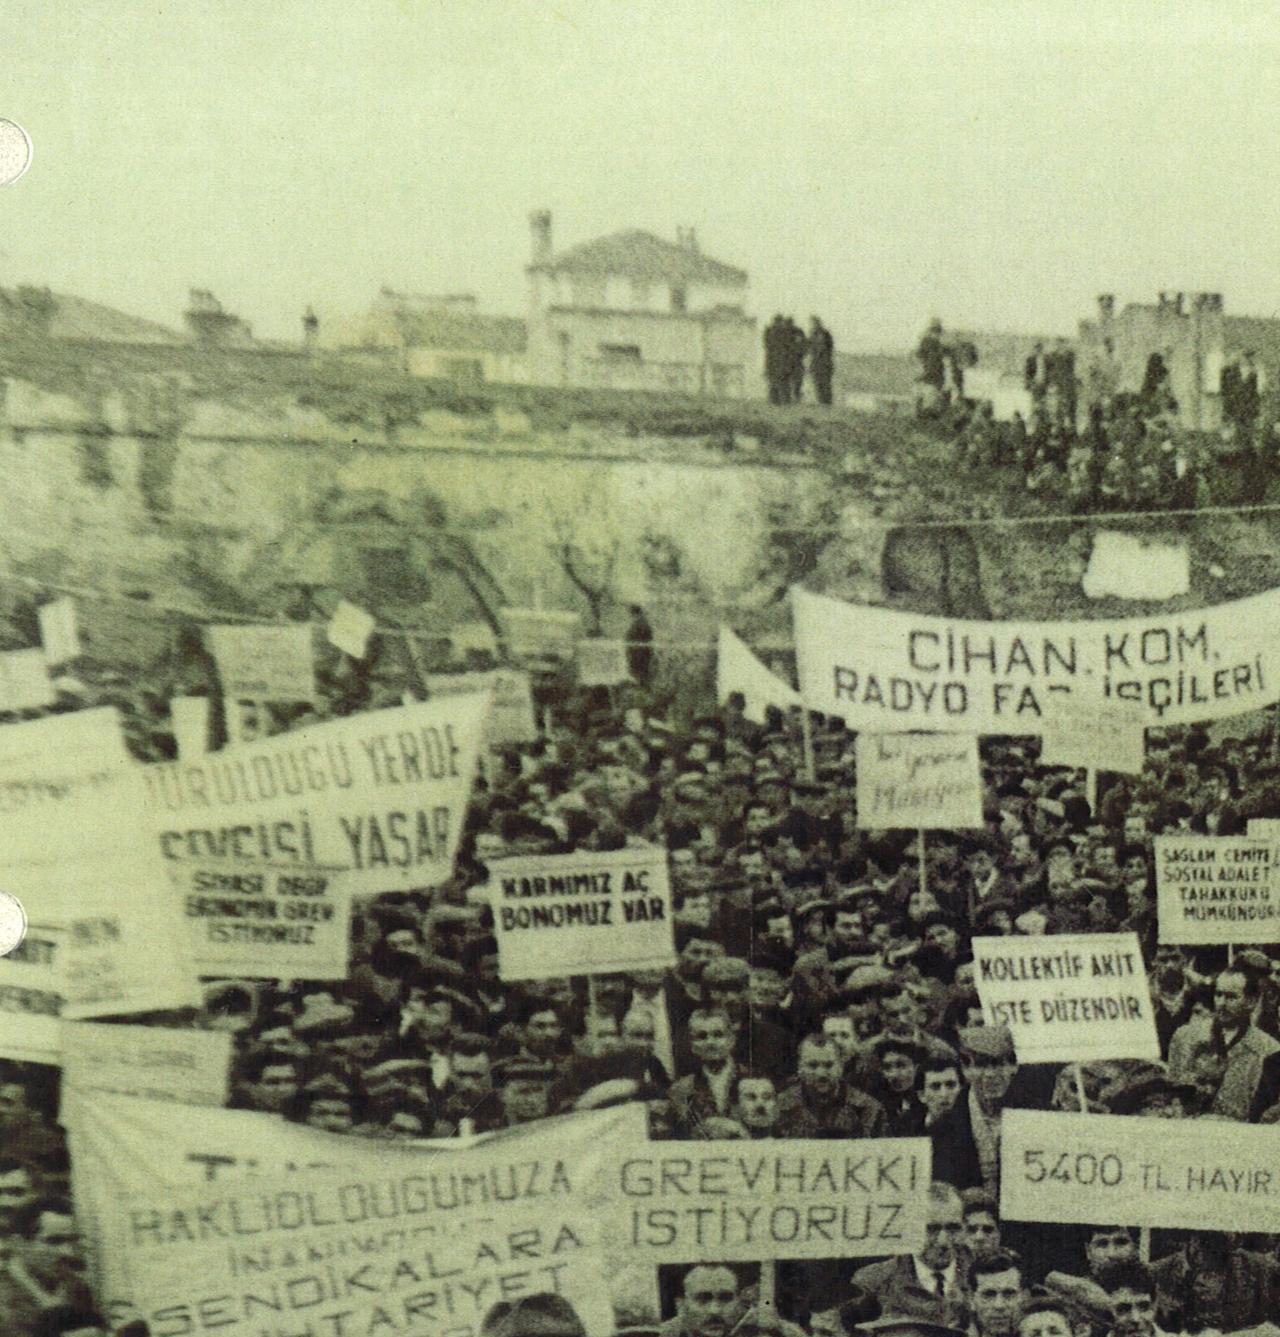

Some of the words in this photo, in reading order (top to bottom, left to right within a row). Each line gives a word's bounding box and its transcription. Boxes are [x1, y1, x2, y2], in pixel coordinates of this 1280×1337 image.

[833, 664, 968, 716] RADYO
[993, 683, 1071, 717] FA
[979, 951, 1084, 982] KOLLEKTİF
[1024, 1150, 1124, 1187] 5400
